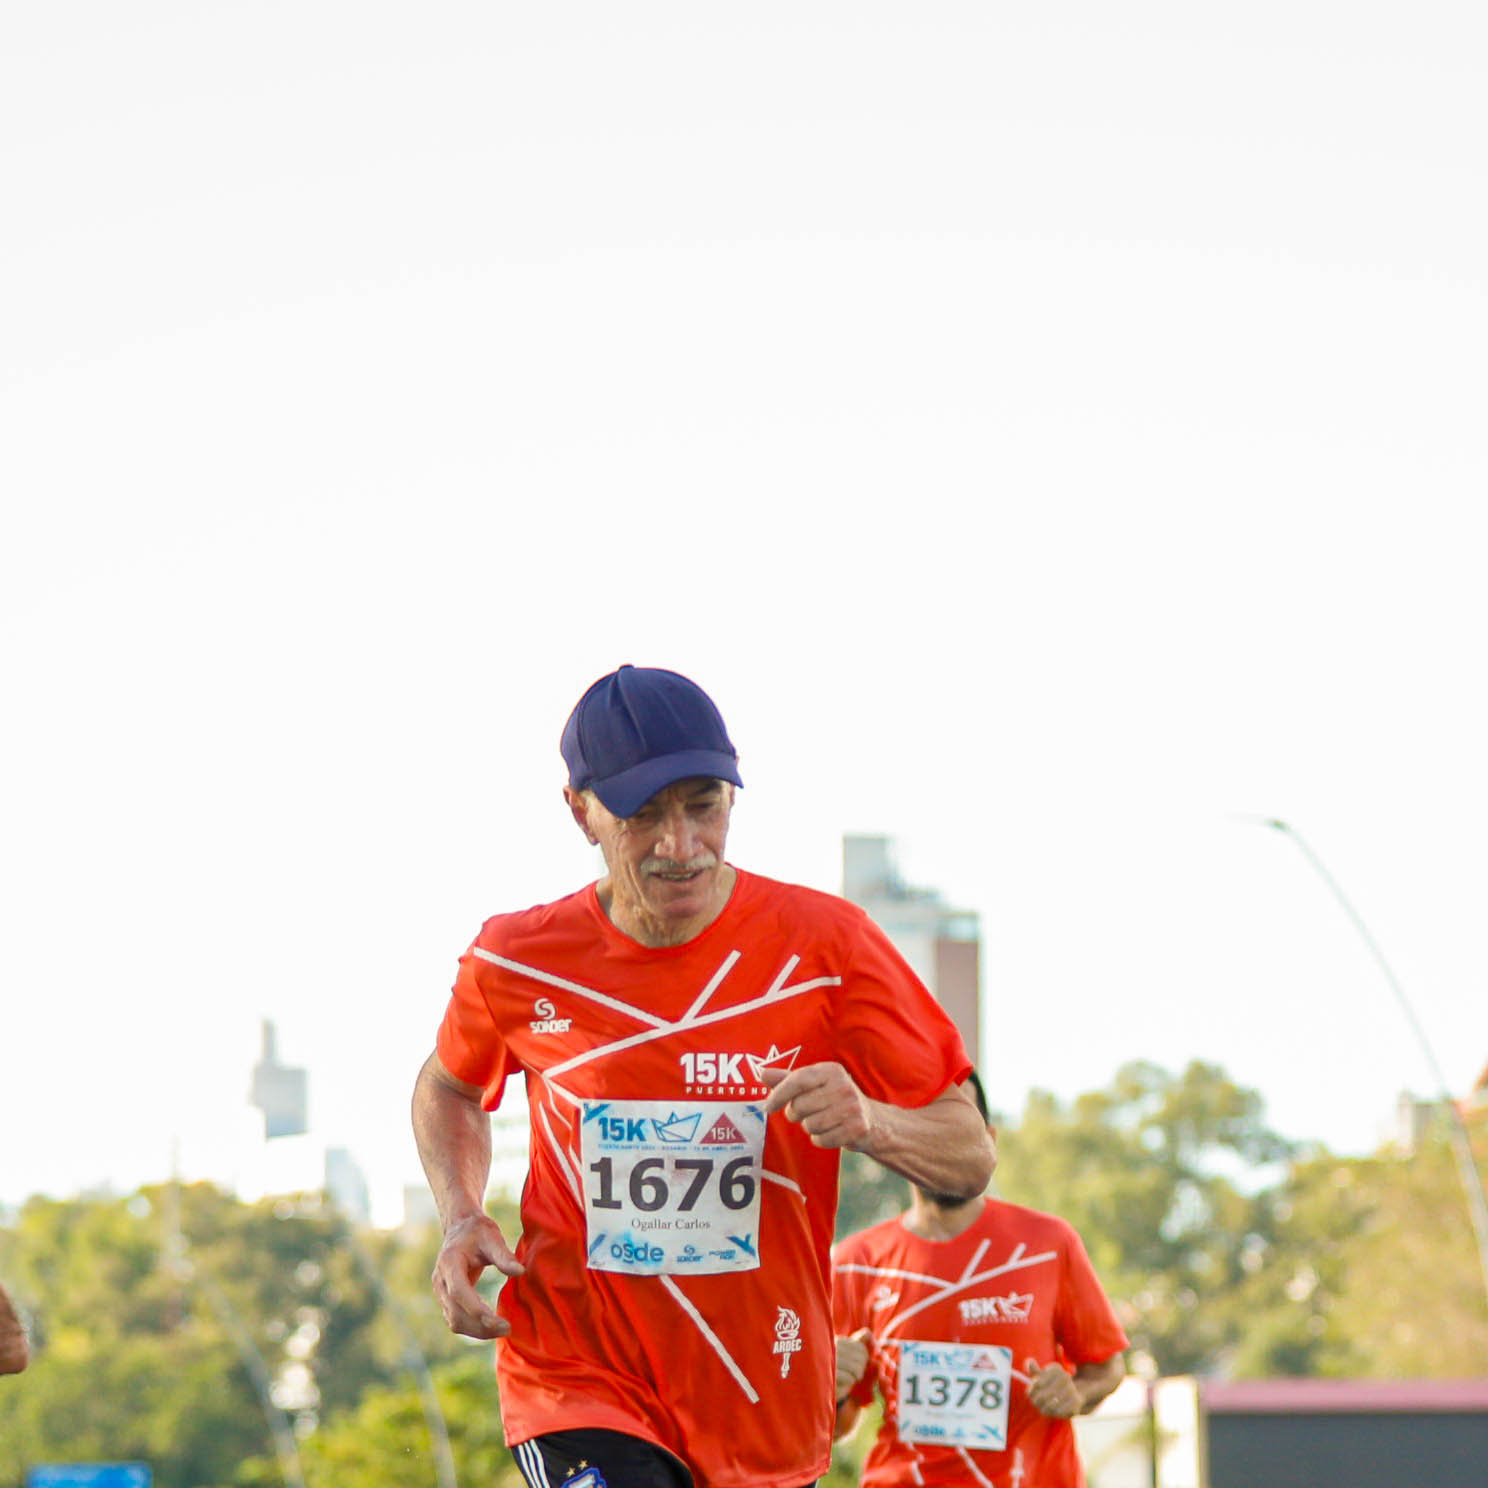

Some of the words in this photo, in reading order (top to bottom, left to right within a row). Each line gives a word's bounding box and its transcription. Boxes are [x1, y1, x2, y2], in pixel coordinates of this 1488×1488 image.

[680, 1052, 745, 1084] 15K
[598, 1117, 647, 1142] 15K
[711, 1126, 737, 1141] 15K
[590, 1156, 756, 1212] 1676
[631, 1218, 672, 1231] Ogallar
[675, 1218, 711, 1230] Carlos
[610, 1242, 664, 1264] osde
[959, 1297, 999, 1320] 15K
[905, 1375, 1003, 1411] 1378
